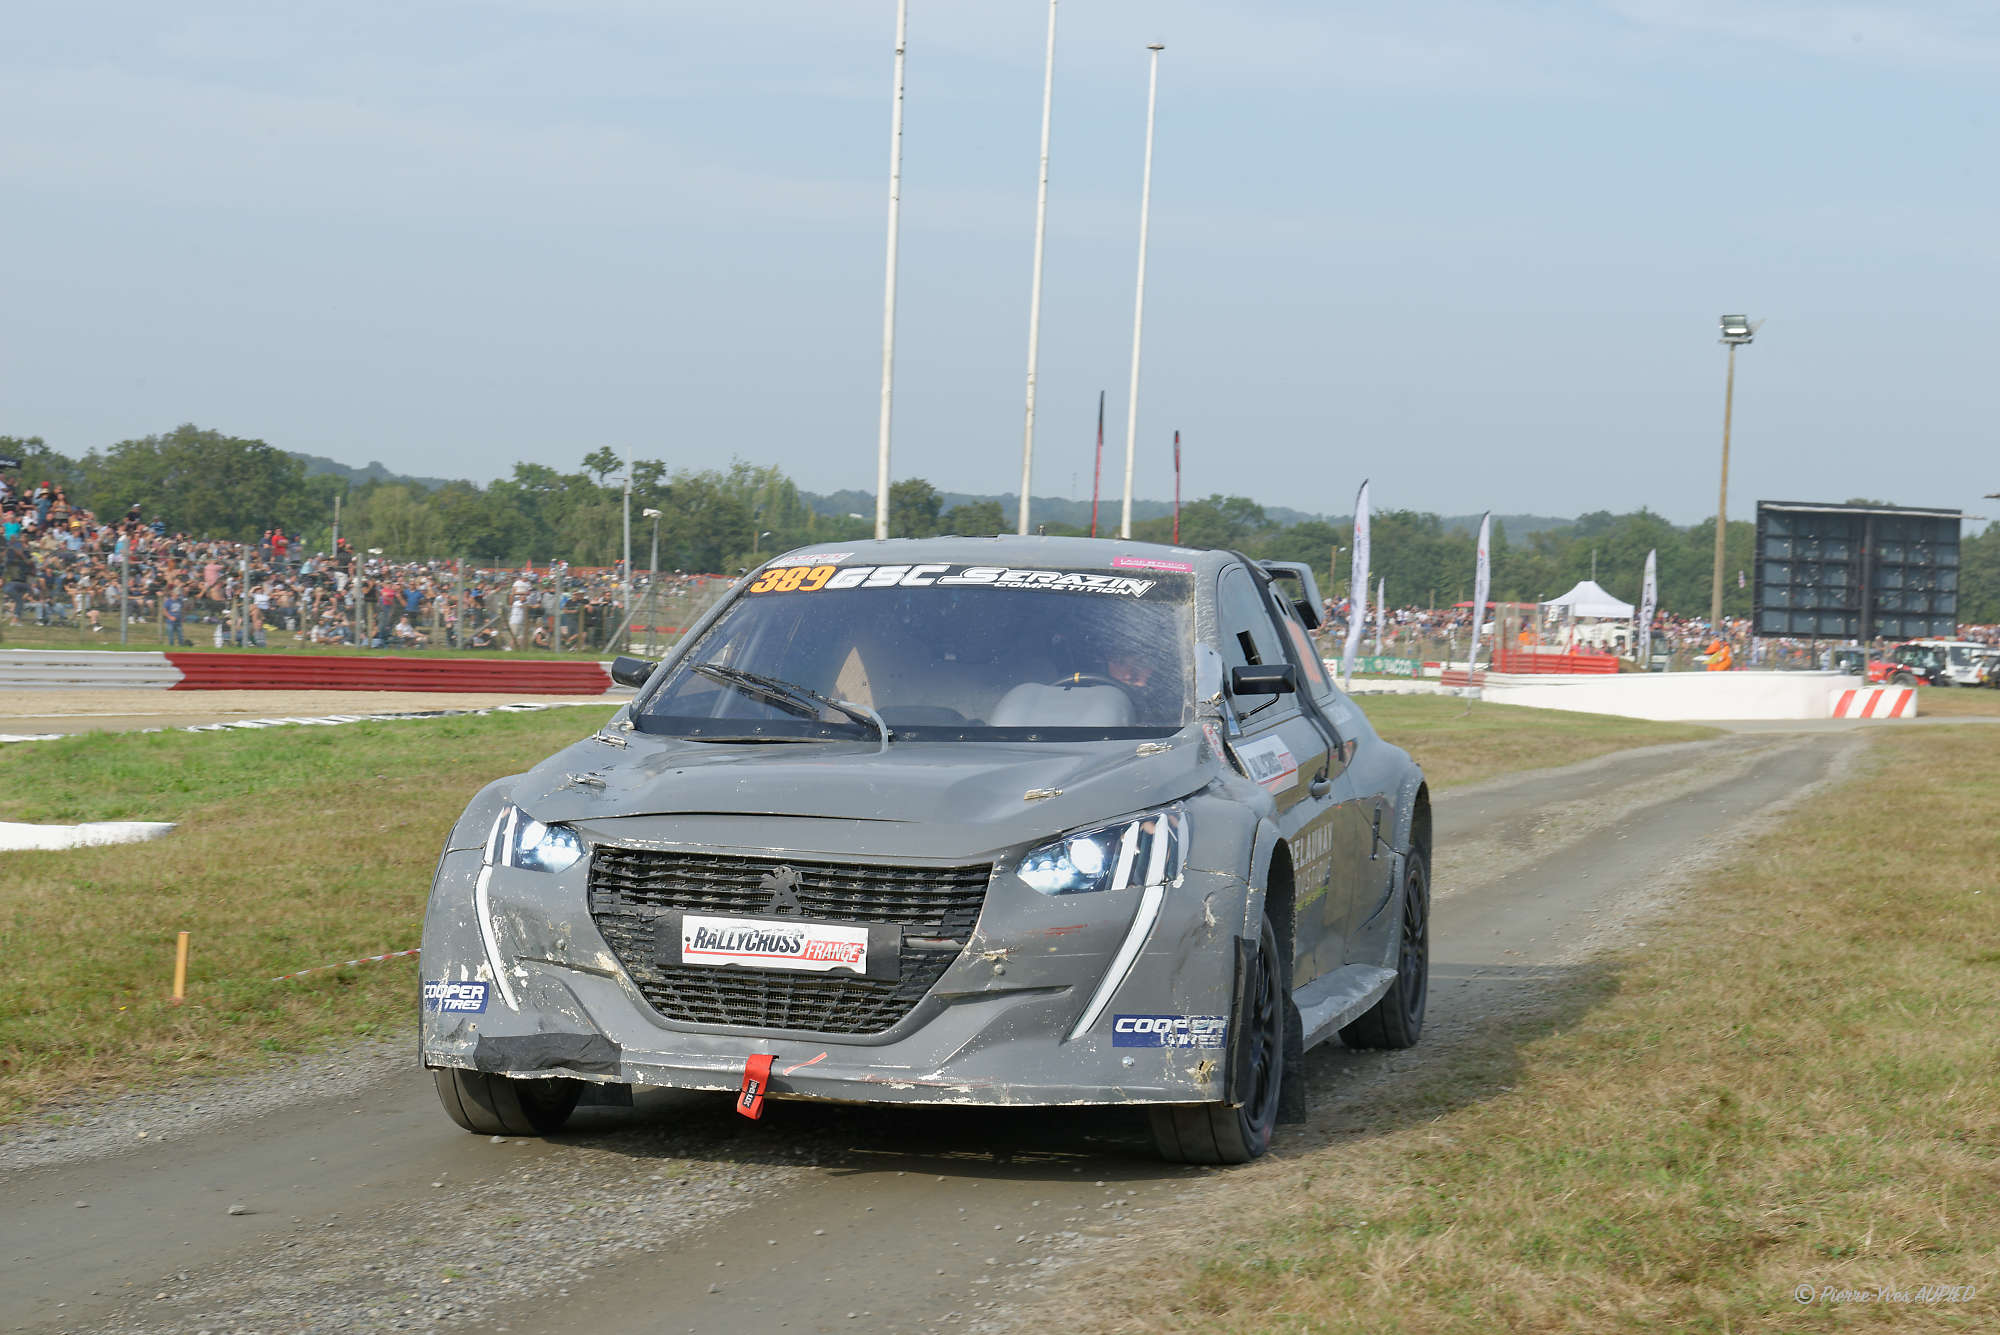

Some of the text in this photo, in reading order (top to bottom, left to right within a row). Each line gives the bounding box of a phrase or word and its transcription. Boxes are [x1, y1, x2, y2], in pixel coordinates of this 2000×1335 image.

[750, 565, 836, 593] 389
[824, 564, 950, 589] GSC
[938, 567, 1156, 597] SERAZIN
[994, 581, 1133, 595] COMPETITION
[806, 940, 862, 963] FRANCE
[424, 984, 485, 1000] COOPER
[443, 999, 482, 1010] TIRES
[1115, 1018, 1227, 1034] COOPER
